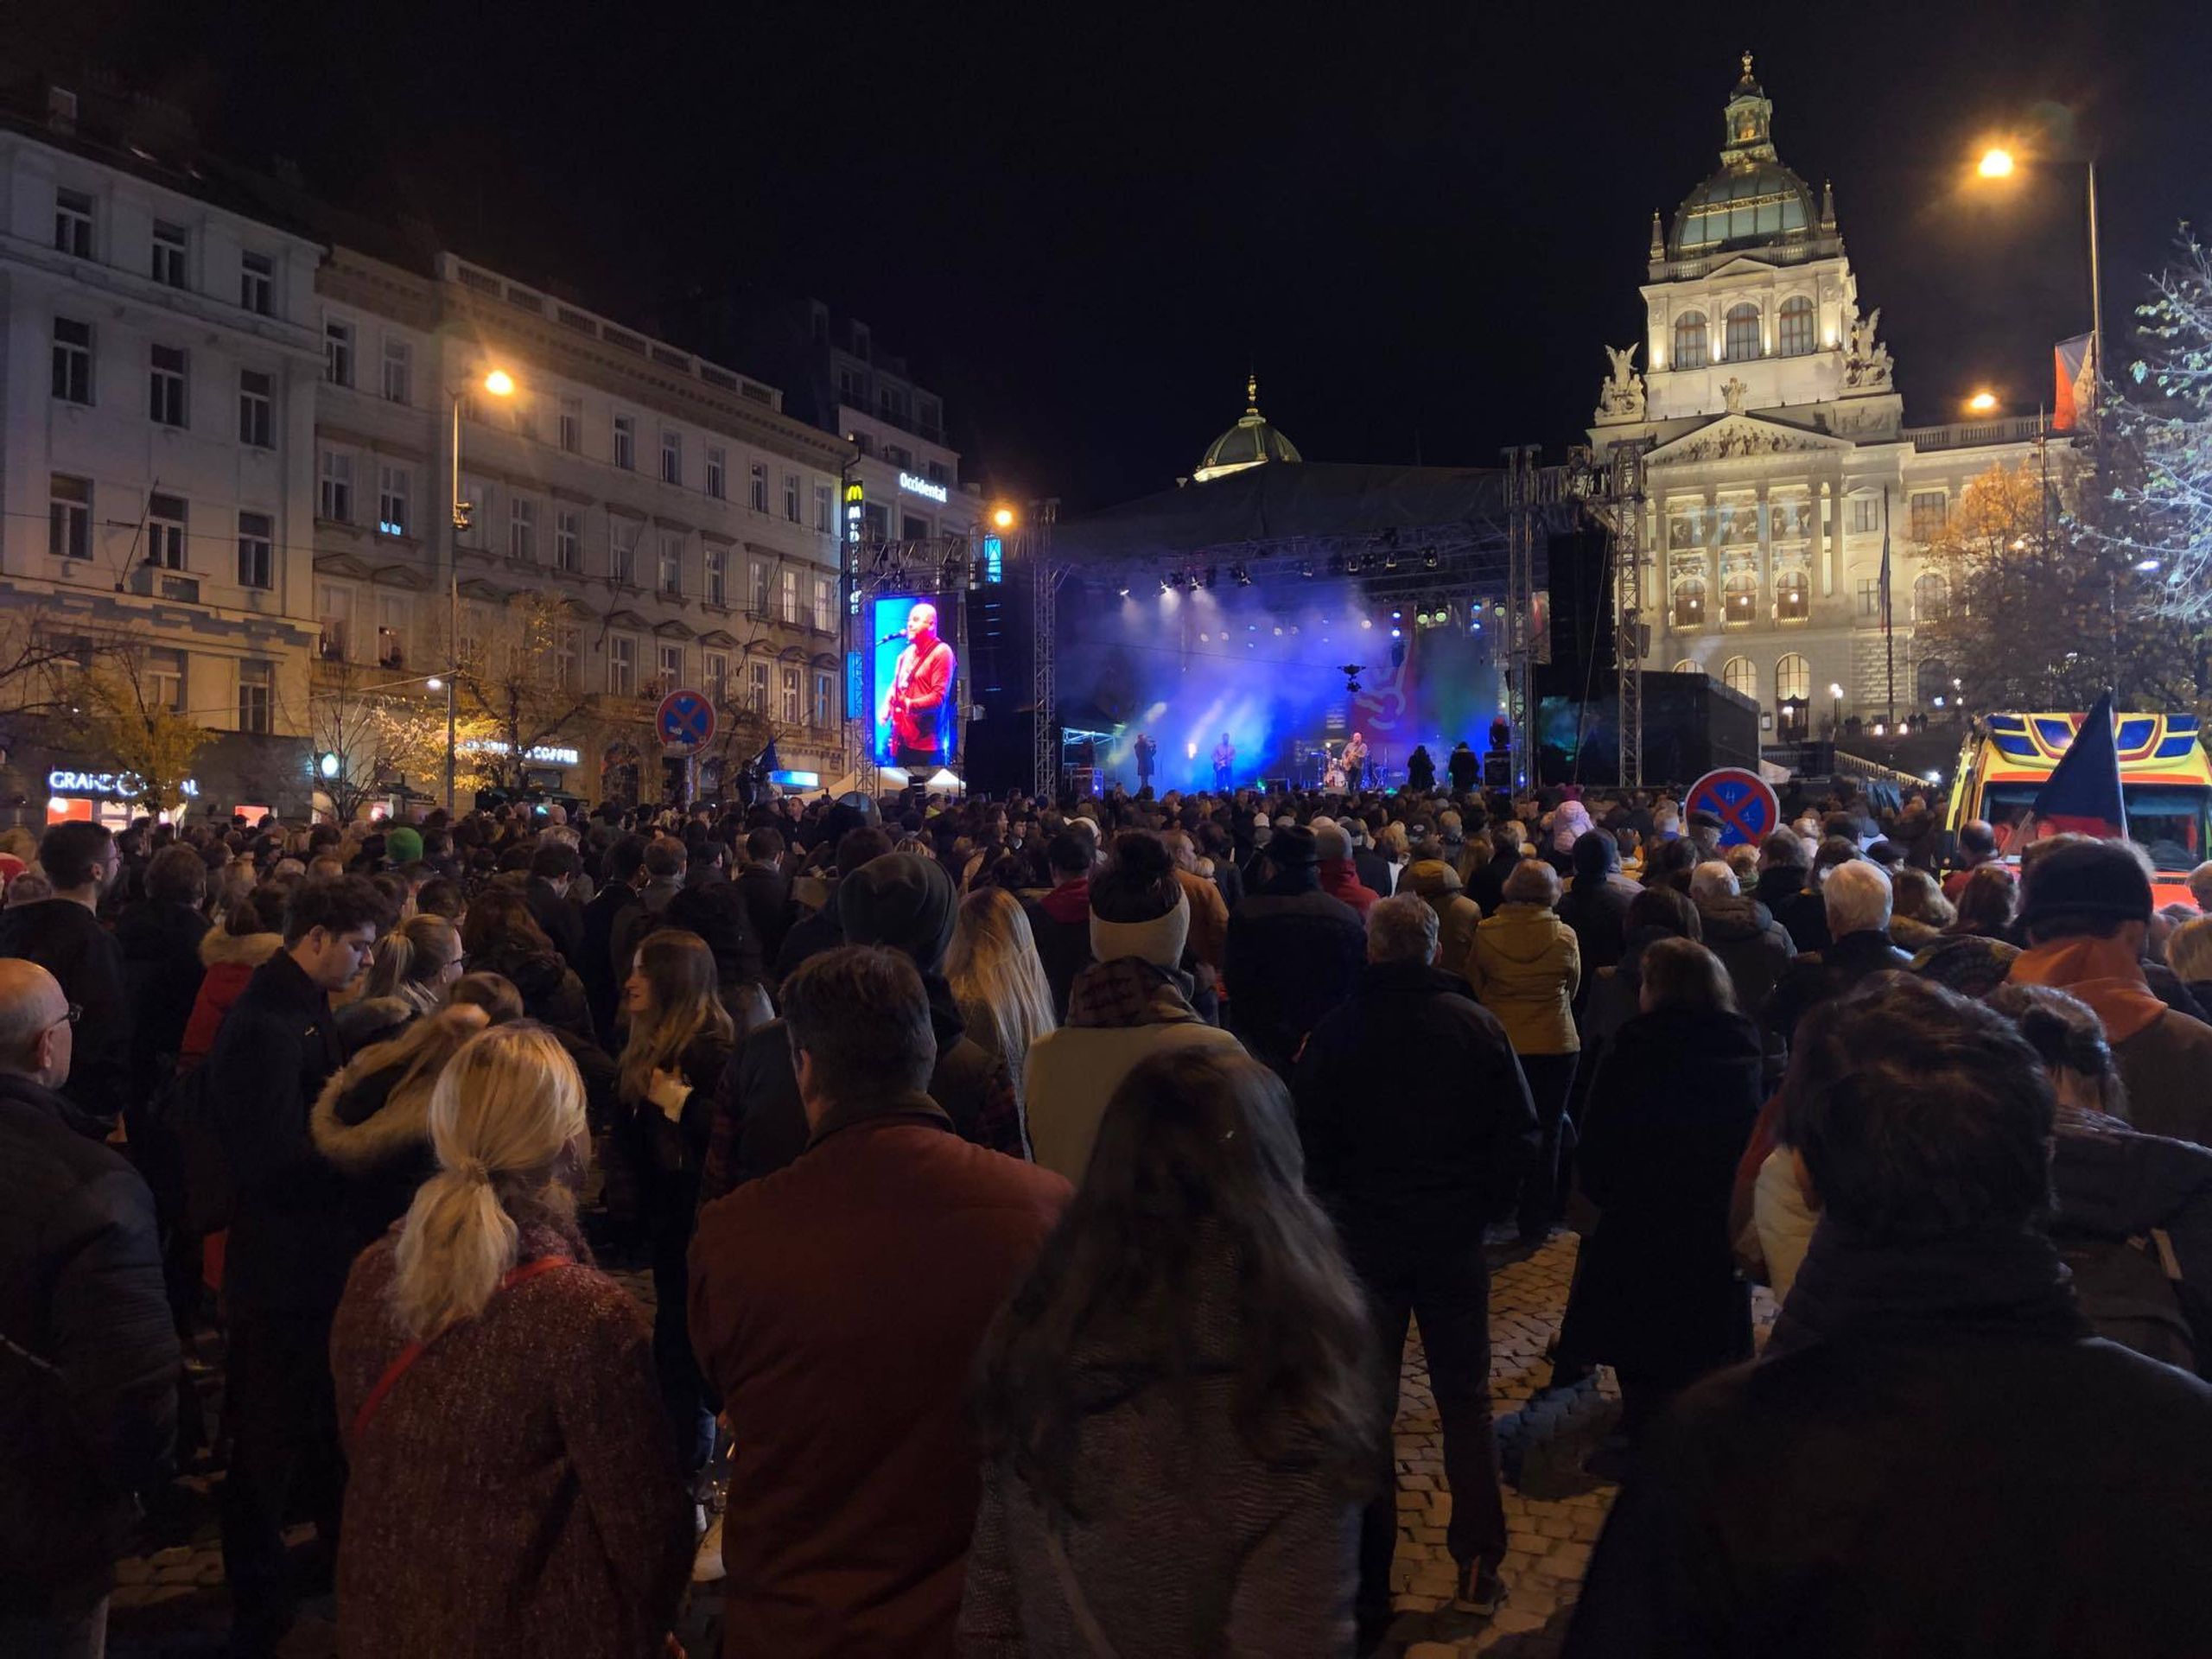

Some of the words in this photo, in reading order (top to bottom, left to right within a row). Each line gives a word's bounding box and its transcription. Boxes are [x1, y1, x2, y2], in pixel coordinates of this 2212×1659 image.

[900, 473, 947, 503] Occidental
[533, 746, 578, 763] COFFEE
[49, 771, 113, 791] GRAND
